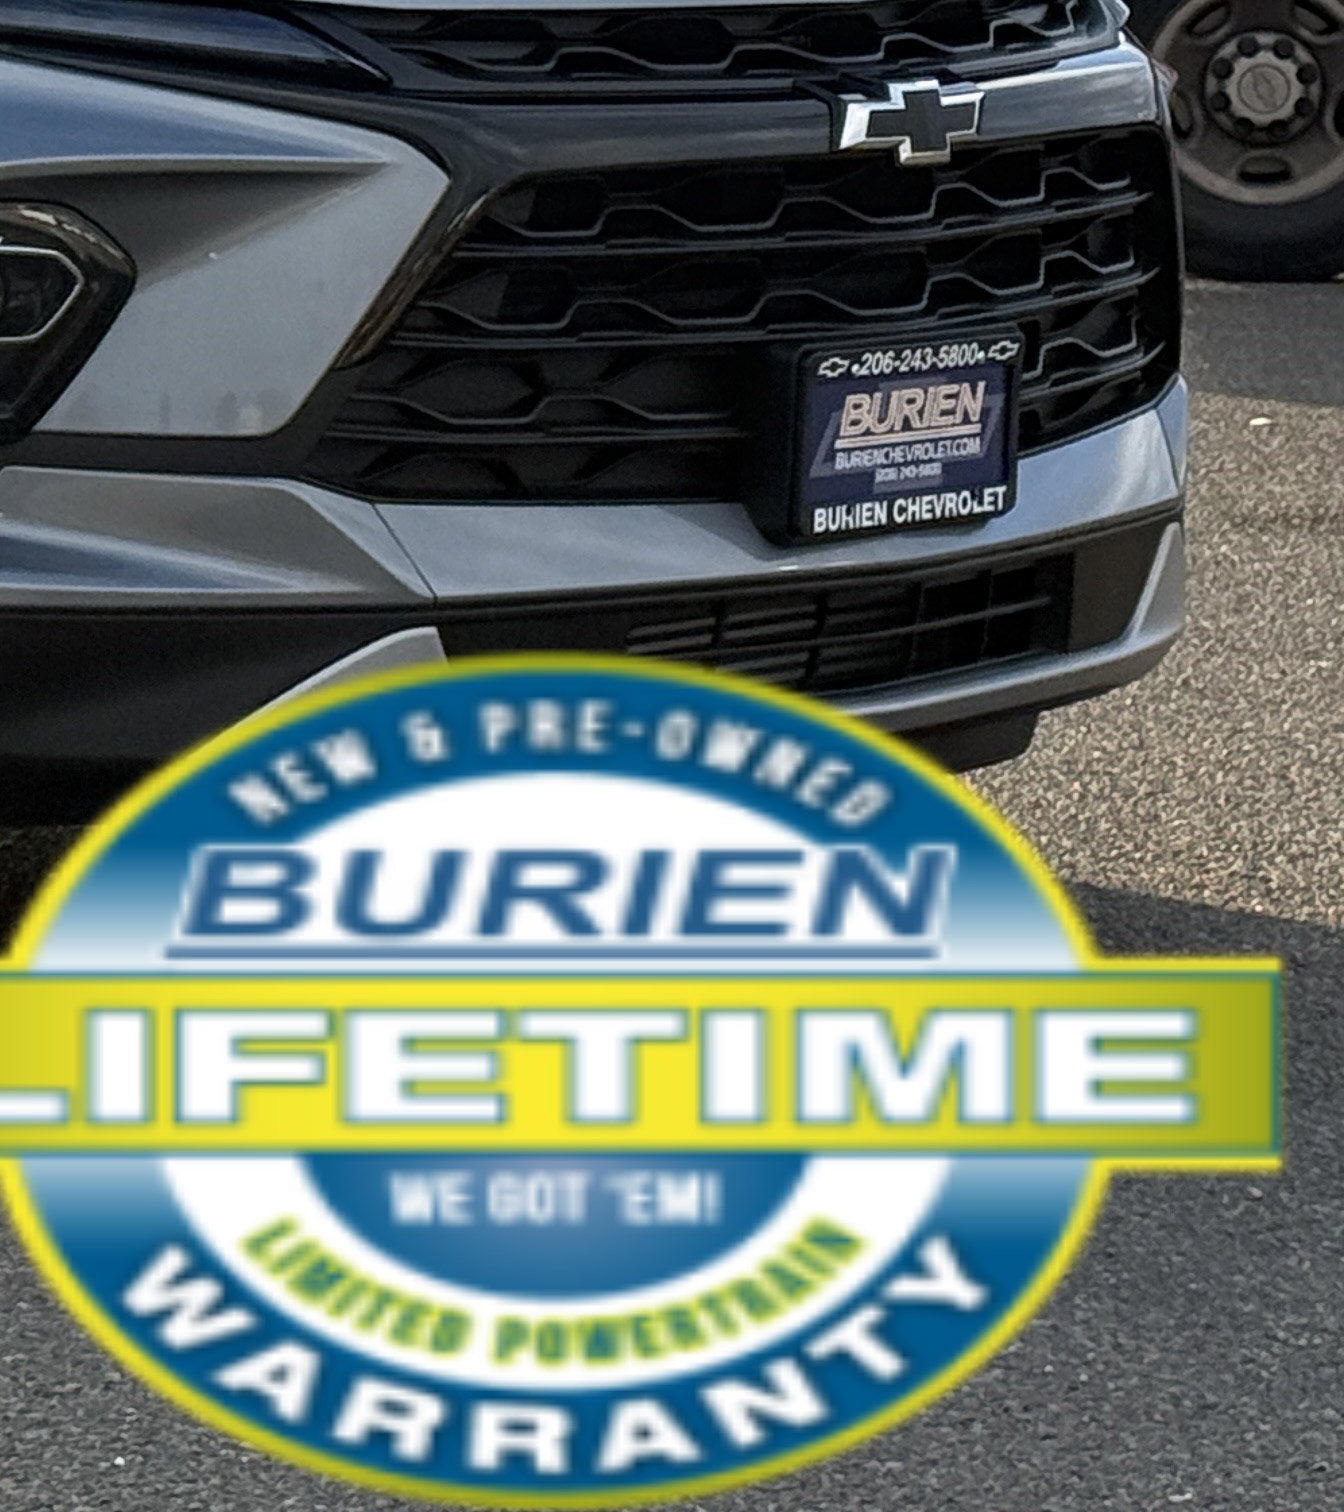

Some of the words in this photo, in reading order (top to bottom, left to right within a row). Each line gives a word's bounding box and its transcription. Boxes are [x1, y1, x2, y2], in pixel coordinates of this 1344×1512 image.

[860, 341, 979, 376] 206-243-5800
[839, 380, 987, 437] BURIEN
[813, 500, 888, 534] BURIEN
[893, 485, 1007, 524] CHEVROLET
